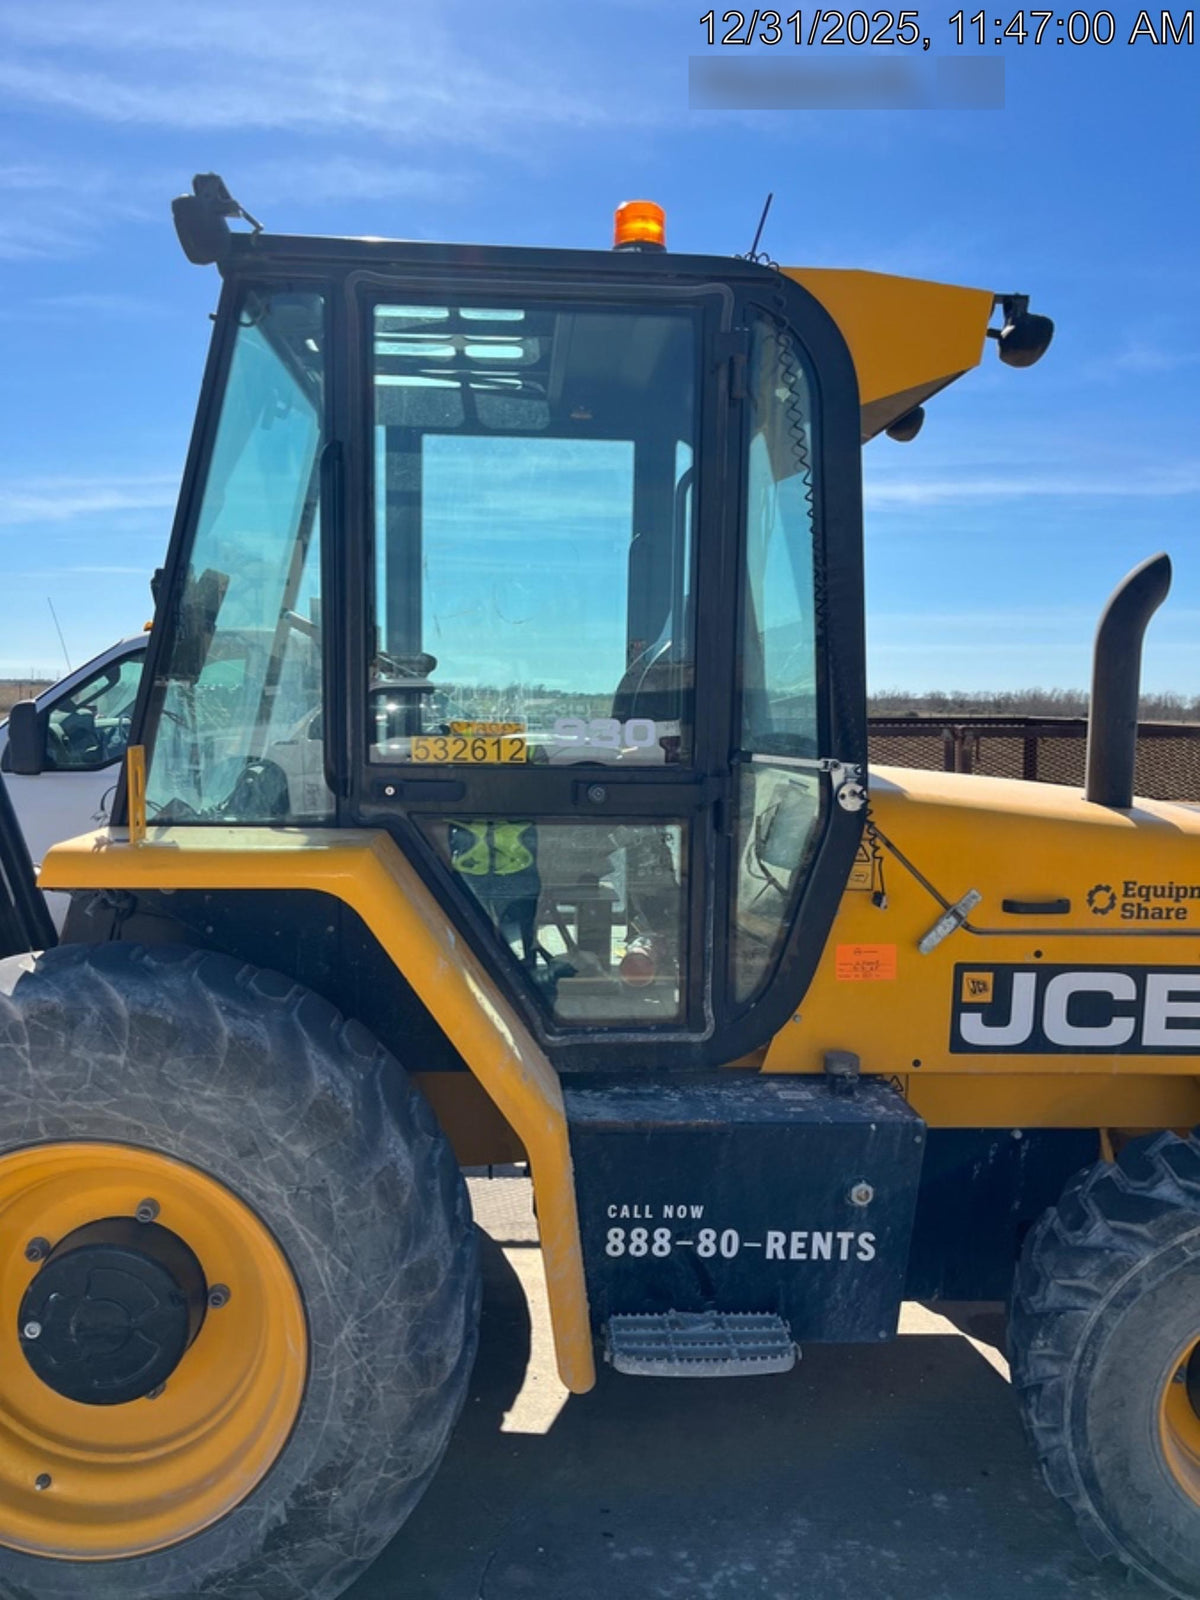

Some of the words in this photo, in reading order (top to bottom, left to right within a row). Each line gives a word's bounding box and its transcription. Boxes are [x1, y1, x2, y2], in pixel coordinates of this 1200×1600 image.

[554, 718, 656, 747] 930
[414, 737, 525, 761] 532612
[1121, 903, 1187, 920] Share
[607, 1205, 653, 1219] CALL
[663, 1205, 705, 1219] NOW
[605, 1227, 876, 1261] 888-80-RENTS
